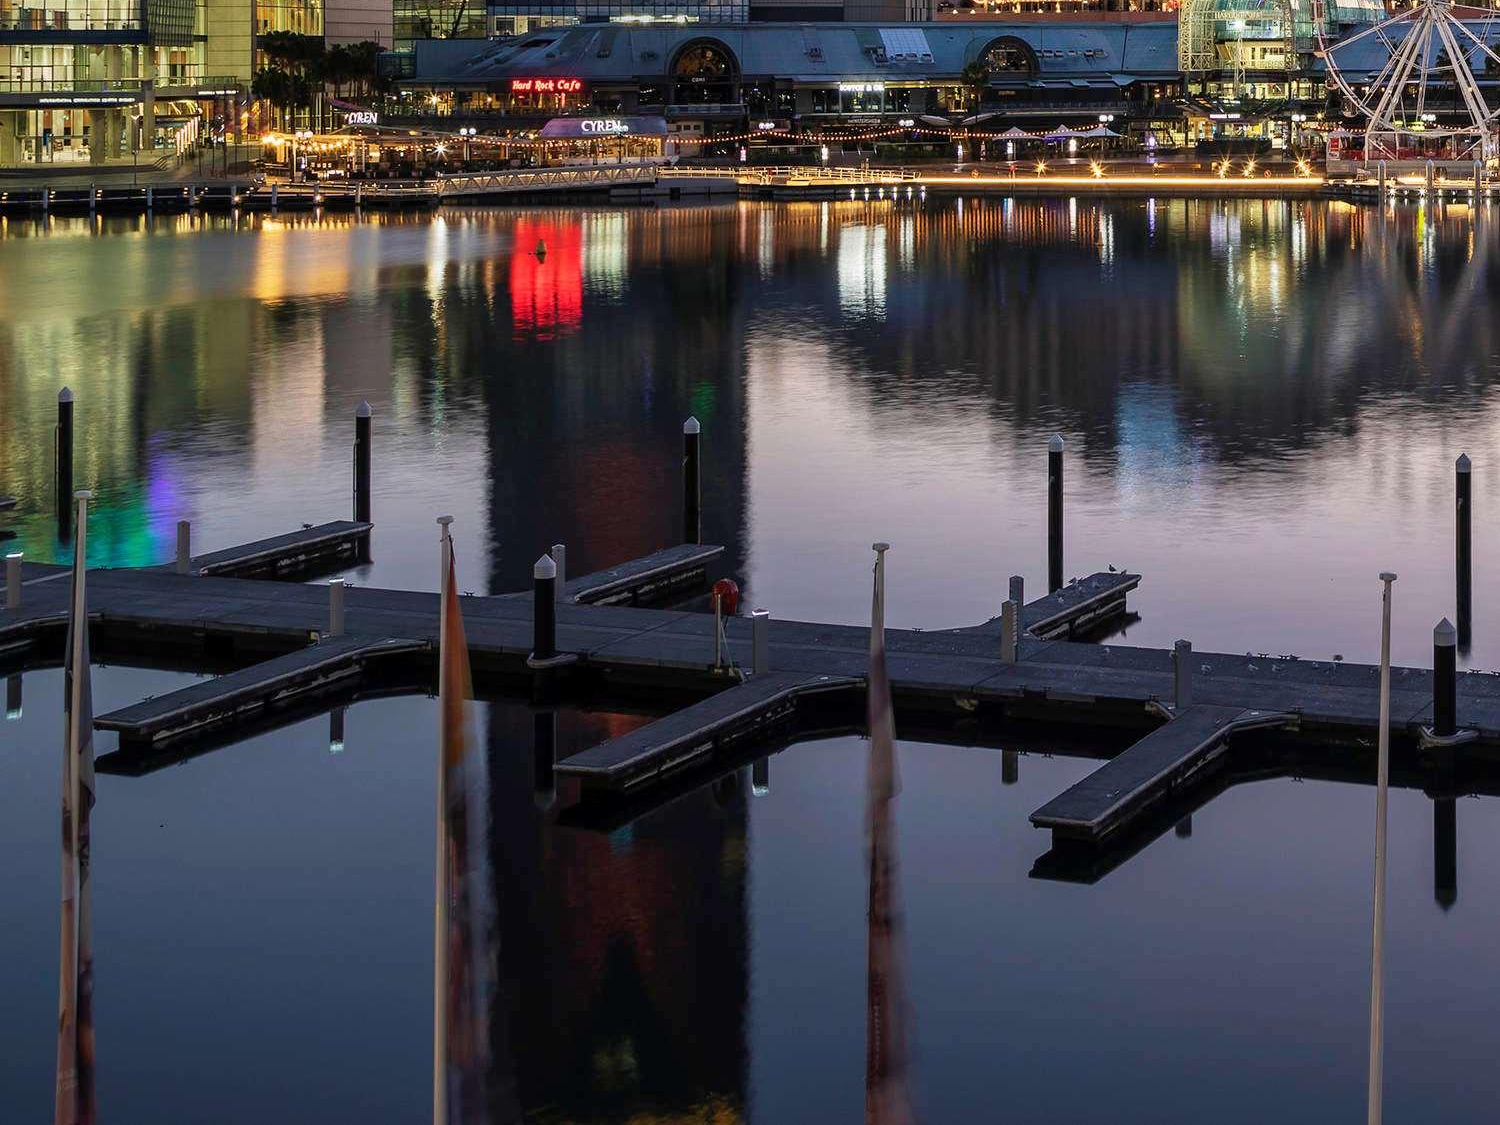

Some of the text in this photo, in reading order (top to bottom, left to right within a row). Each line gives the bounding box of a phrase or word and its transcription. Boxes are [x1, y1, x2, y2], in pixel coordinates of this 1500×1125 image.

[512, 79, 581, 92] Hard Rock Cafe
[581, 119, 621, 132] CYREN
